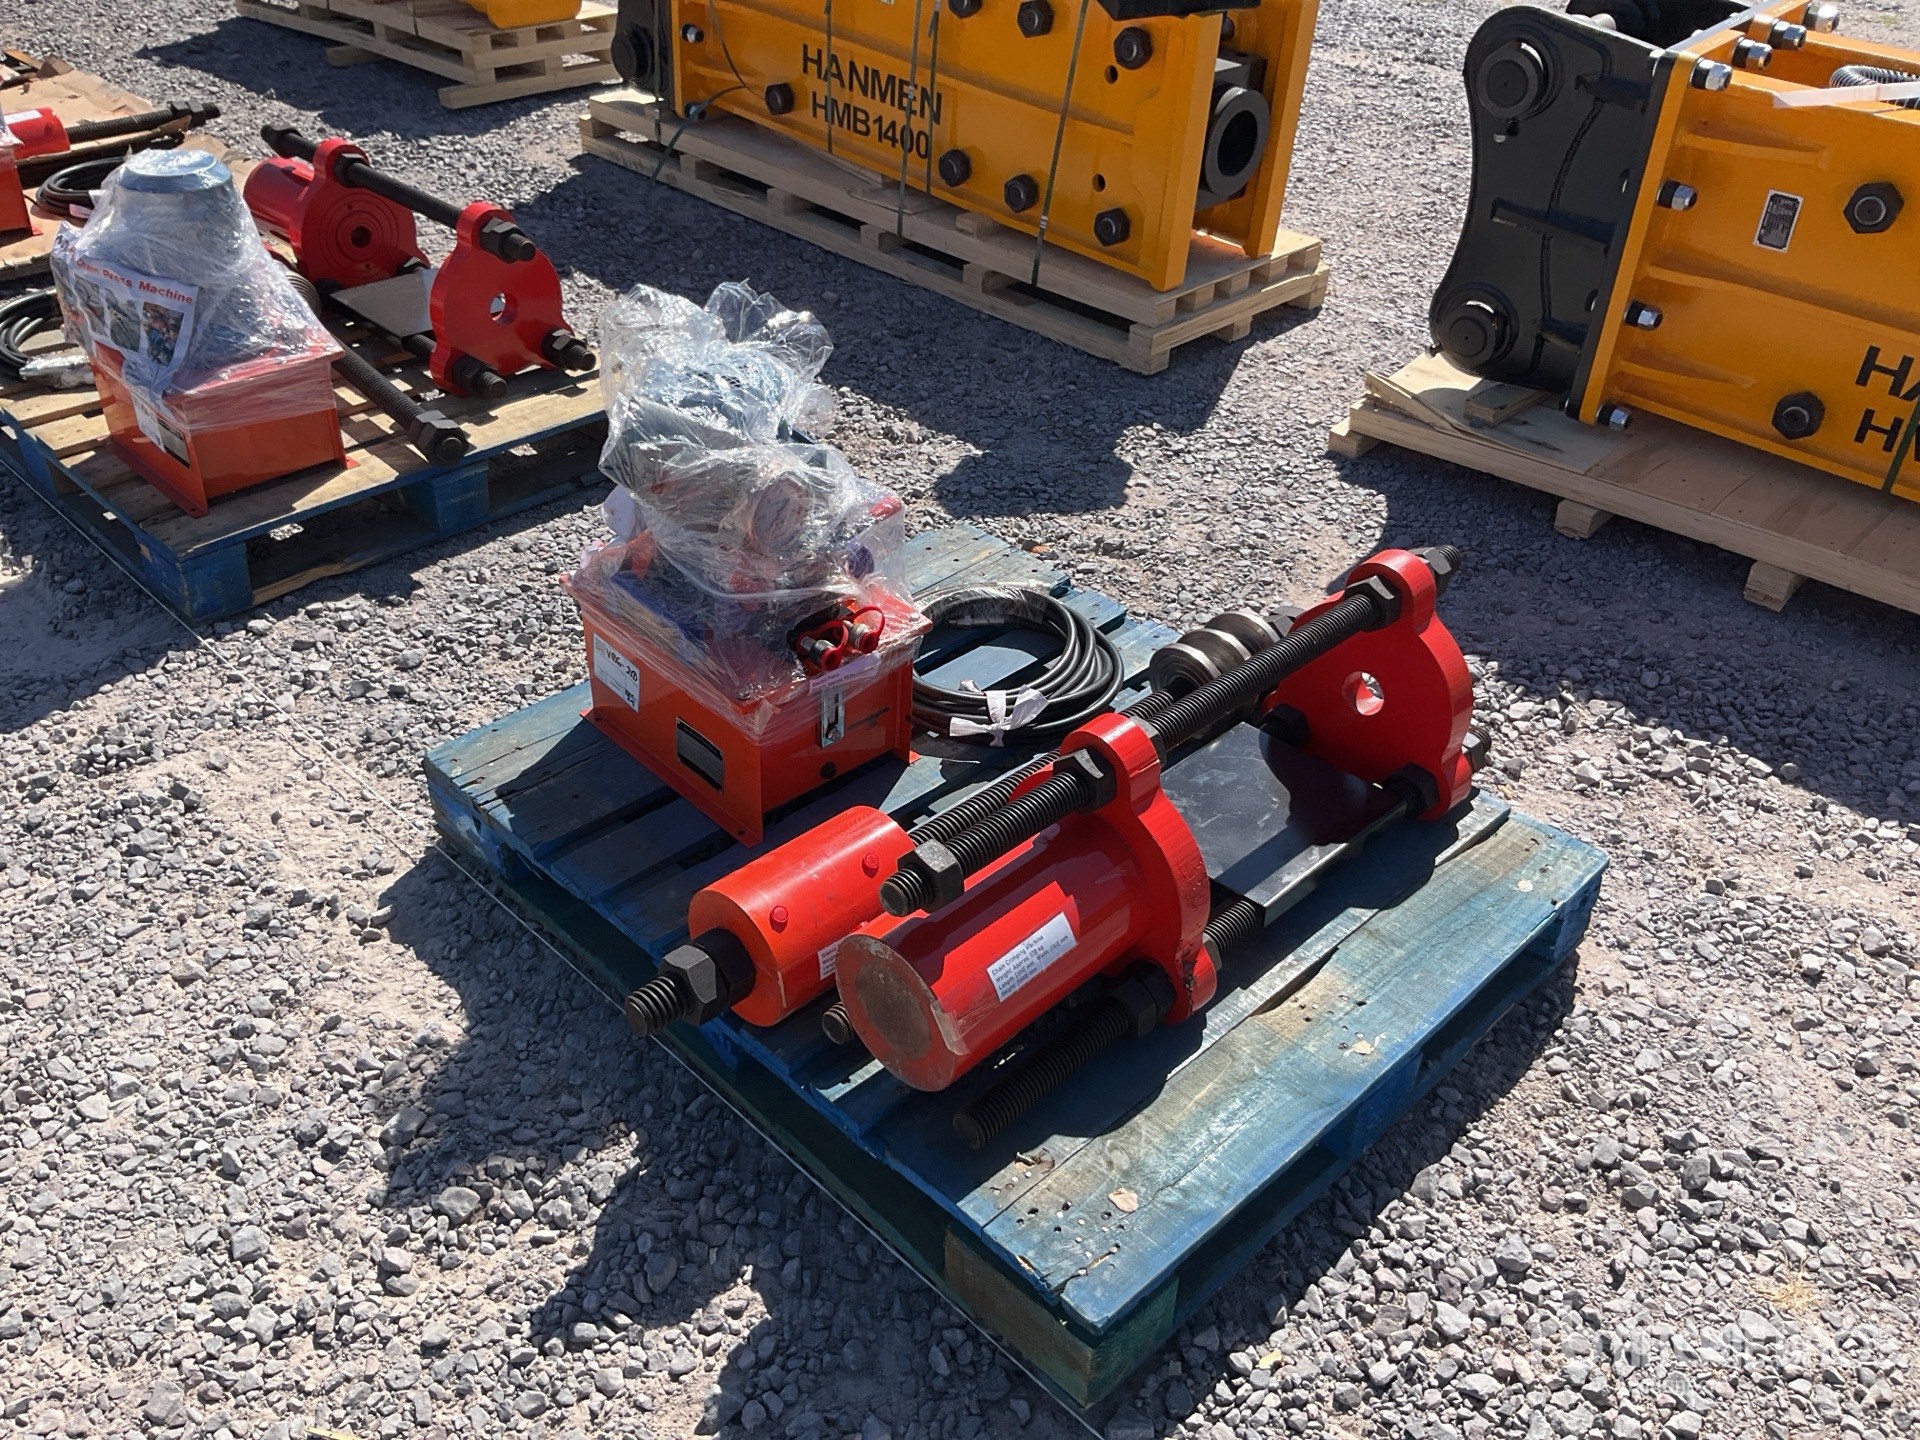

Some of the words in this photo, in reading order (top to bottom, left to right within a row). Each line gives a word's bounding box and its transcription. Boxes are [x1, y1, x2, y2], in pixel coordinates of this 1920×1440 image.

[803, 43, 942, 126] HANMEN
[812, 91, 930, 160] HMB1400
[138, 281, 193, 304] Machine
